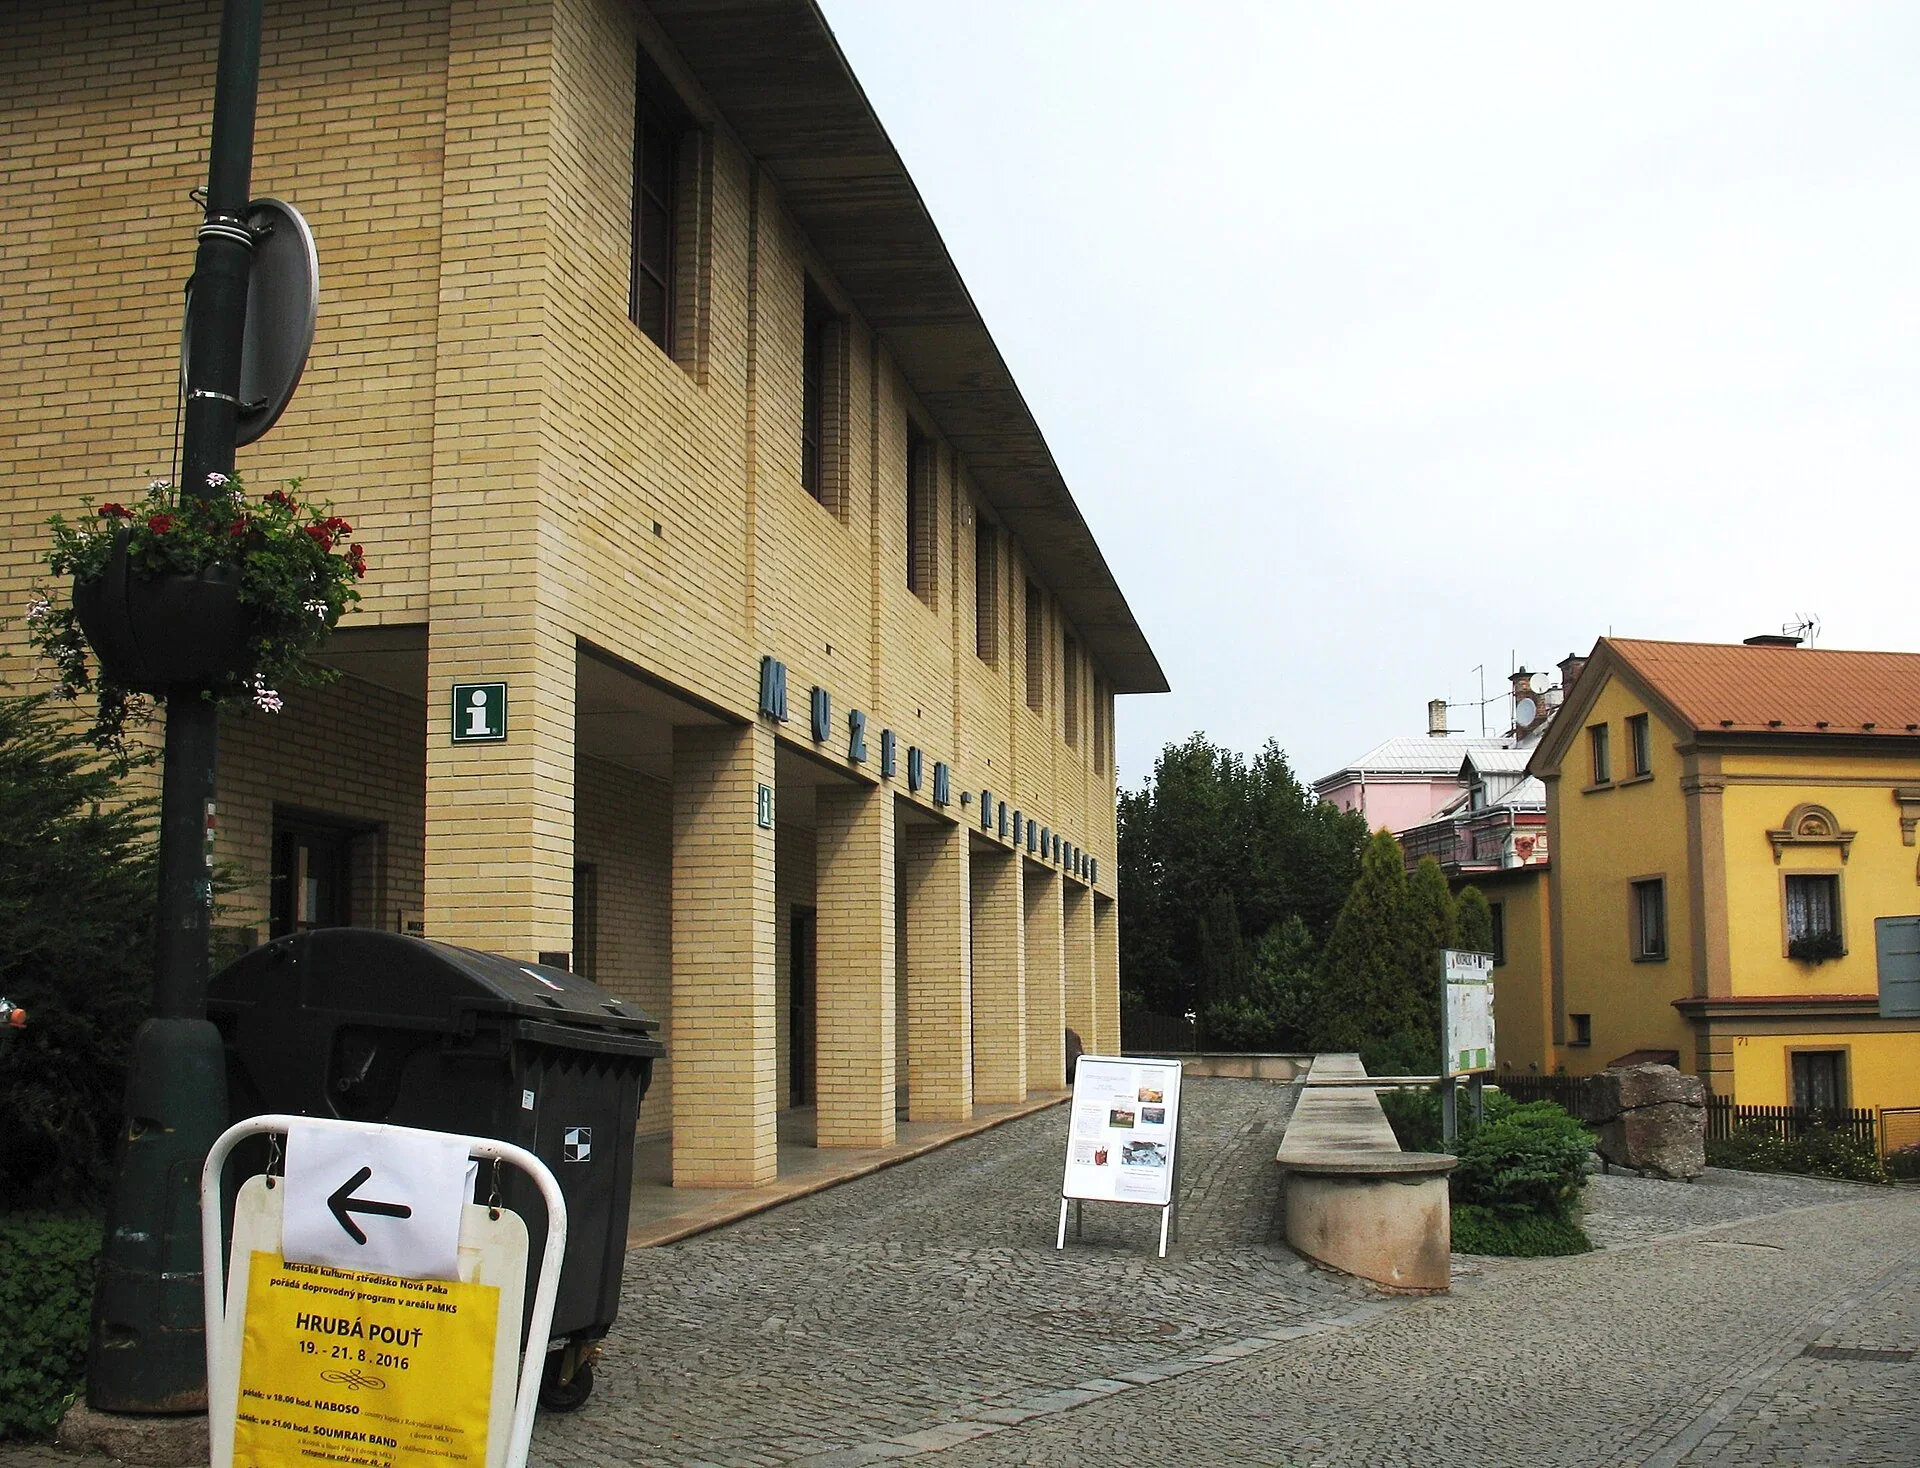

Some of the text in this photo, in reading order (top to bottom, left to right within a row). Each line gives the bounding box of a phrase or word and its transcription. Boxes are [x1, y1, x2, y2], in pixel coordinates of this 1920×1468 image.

[759, 655, 950, 806] MUZEUM
[270, 1278, 300, 1289] pořádá
[302, 1282, 356, 1299] doprovodný
[357, 1291, 395, 1304] program
[406, 1300, 435, 1310] areálu
[437, 1303, 457, 1314] MKS
[320, 1267, 355, 1280] kulturní
[356, 1274, 397, 1287] středisko
[400, 1280, 423, 1291] Nová
[426, 1284, 448, 1295] Paka
[296, 1312, 423, 1348] HRUBÁ POUŤ
[299, 1340, 318, 1355] 19.
[273, 1394, 294, 1404] 18.00
[295, 1398, 312, 1408] hod.
[314, 1400, 360, 1415] NABOSO
[260, 1418, 270, 1426] ve
[272, 1419, 292, 1430] 21.00
[293, 1423, 310, 1433] hod.
[313, 1425, 366, 1442] SOUMRAK
[369, 1434, 397, 1448] BAND
